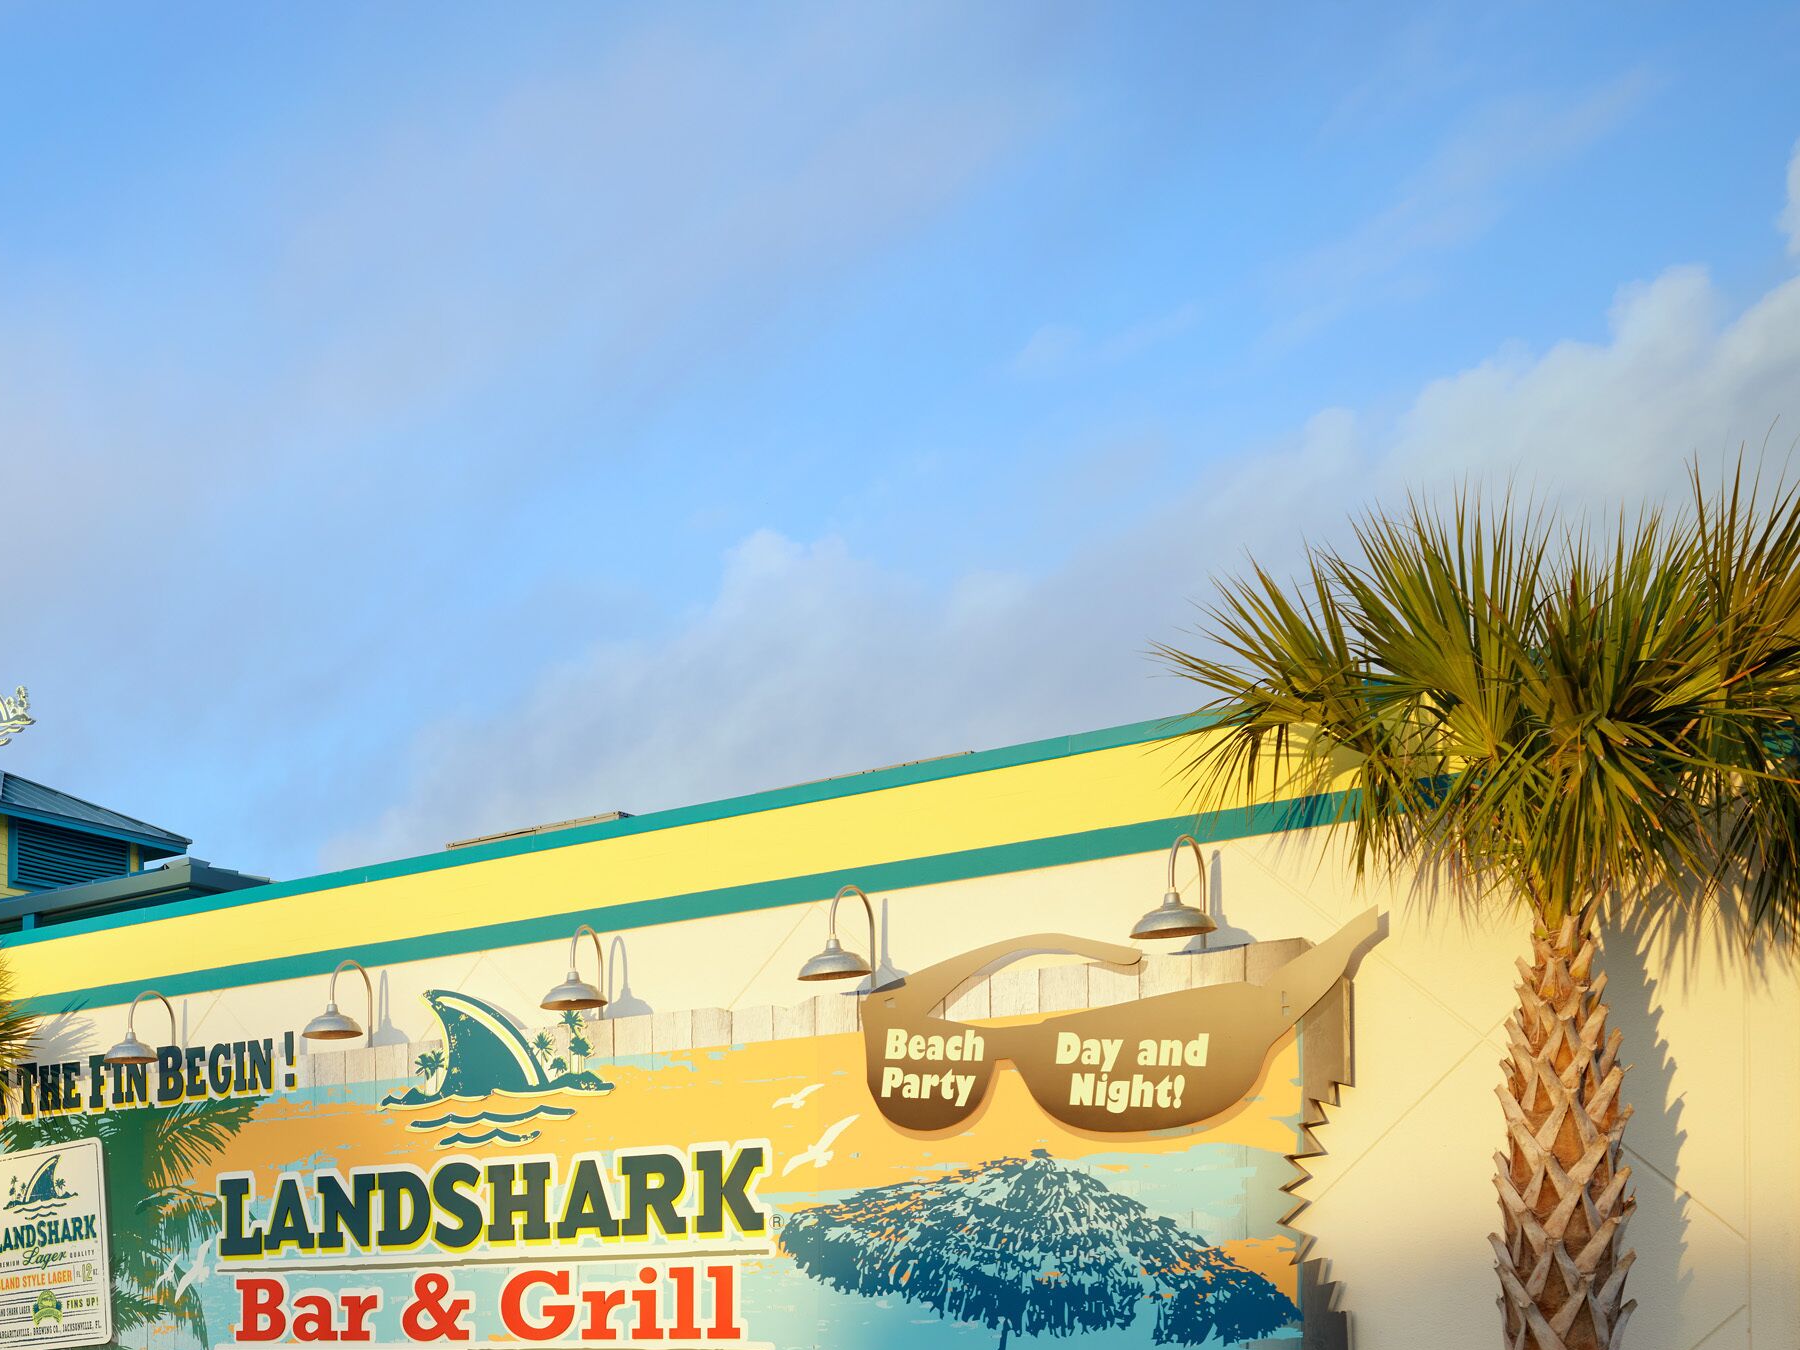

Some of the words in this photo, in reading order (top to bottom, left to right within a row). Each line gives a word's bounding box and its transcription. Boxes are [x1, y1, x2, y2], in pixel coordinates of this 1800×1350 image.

[885, 1029, 985, 1062] Beach
[1055, 1031, 1124, 1072] Day
[1137, 1033, 1209, 1067] and
[17, 1062, 81, 1115] THE
[89, 1054, 147, 1108] FIN
[880, 1066, 976, 1107] Party
[1069, 1073, 1186, 1113] Night!
[219, 1146, 765, 1256] LANDSHARK
[22, 1247, 67, 1270] Lager
[69, 1249, 95, 1259] QUALITY
[23, 1273, 46, 1288] STYLE
[48, 1270, 73, 1285] LAGER
[81, 1263, 93, 1282] 12
[6, 1306, 19, 1316] SHARK
[66, 1298, 84, 1309] FINS
[86, 1297, 99, 1307] UP!
[236, 1278, 377, 1341] Bar
[402, 1273, 470, 1341] &
[500, 1266, 742, 1340] Grill
[33, 1325, 52, 1336] BREWING
